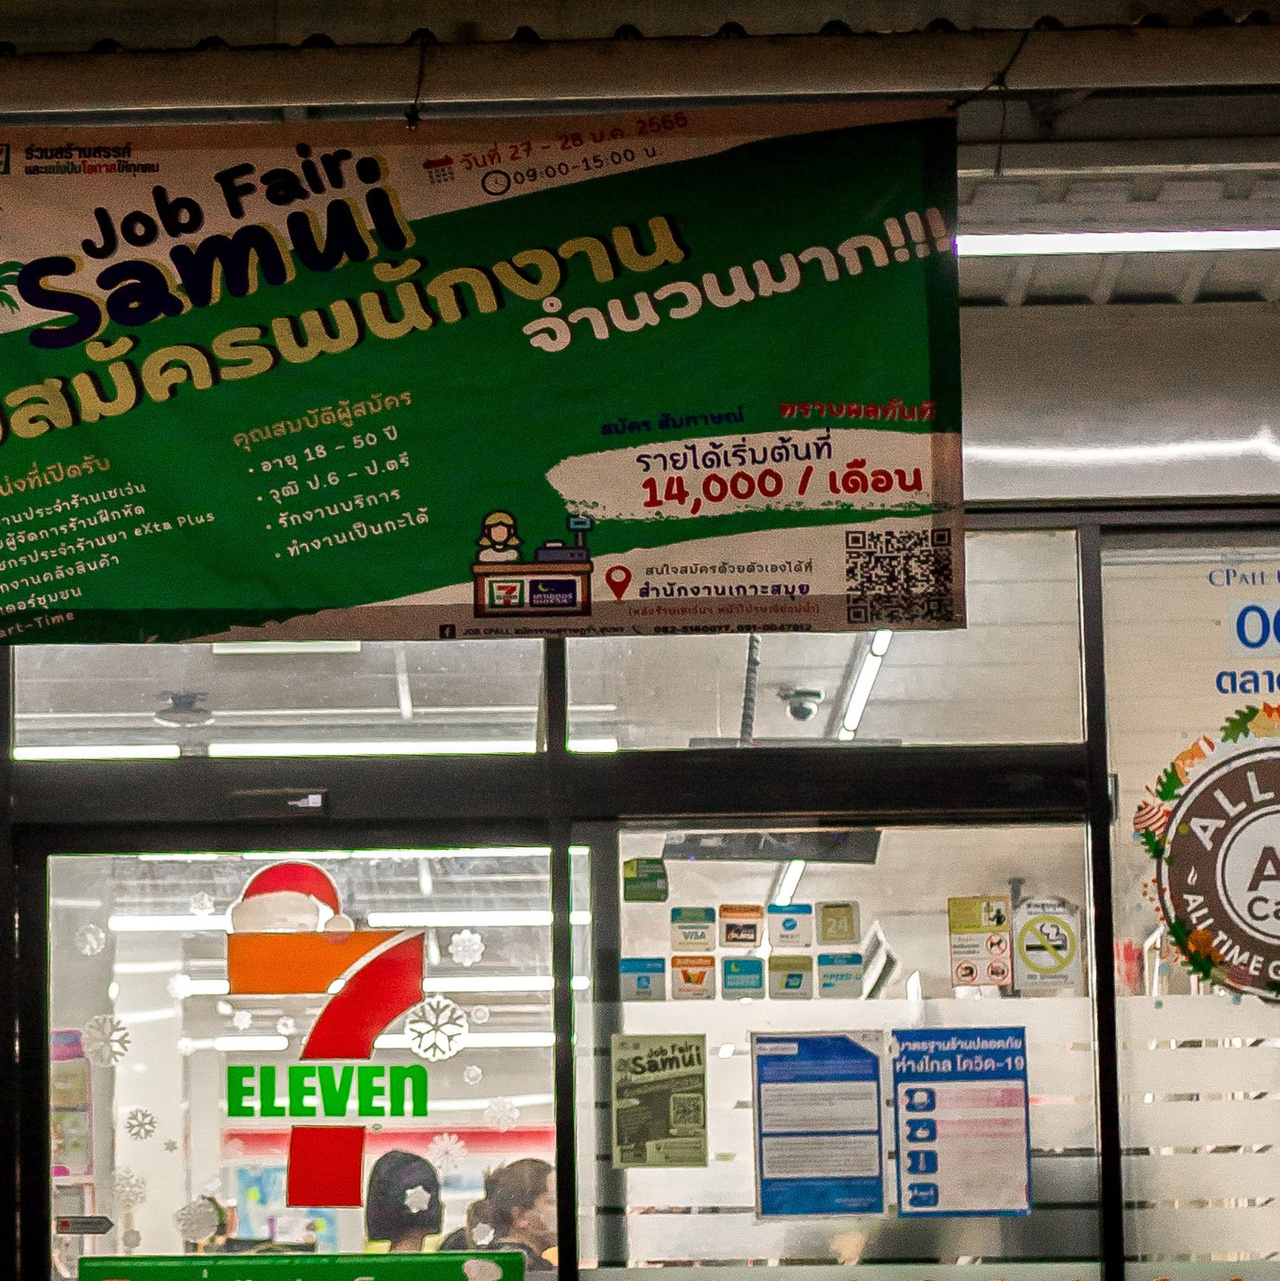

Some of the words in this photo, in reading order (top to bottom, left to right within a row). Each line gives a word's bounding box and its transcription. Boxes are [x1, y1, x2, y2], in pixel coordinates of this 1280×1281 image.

[508, 141, 532, 161] 27
[80, 184, 206, 260] Job
[214, 142, 354, 219] Fair
[17, 154, 417, 350] Samui
[522, 206, 951, 353] จำนวนมาก!!!
[232, 389, 414, 453] คุณสมบัติผู้สมัคร
[260, 452, 300, 472] อายุ
[303, 444, 328, 463] 18
[352, 432, 379, 450] 50
[382, 424, 399, 443] ปี
[635, 426, 834, 474] รายได้เริ่มต้นที่
[269, 480, 301, 505] วุฒิ
[306, 471, 341, 492] ป.6
[364, 451, 411, 477] ป.ตรี
[640, 467, 785, 517] 14,000
[795, 464, 816, 497] /
[827, 457, 925, 496] เดือน
[133, 518, 173, 538] eXta
[177, 510, 217, 529] Plus
[278, 488, 403, 528] รักงานบริการ
[286, 506, 431, 558] ทำงานเป็นกะได้
[638, 581, 811, 602] สำนักงานเกาะสมุย
[1236, 604, 1280, 649] 0
[1216, 670, 1280, 695] ตลา
[1212, 929, 1265, 977] TIME
[632, 1044, 702, 1075] Samui
